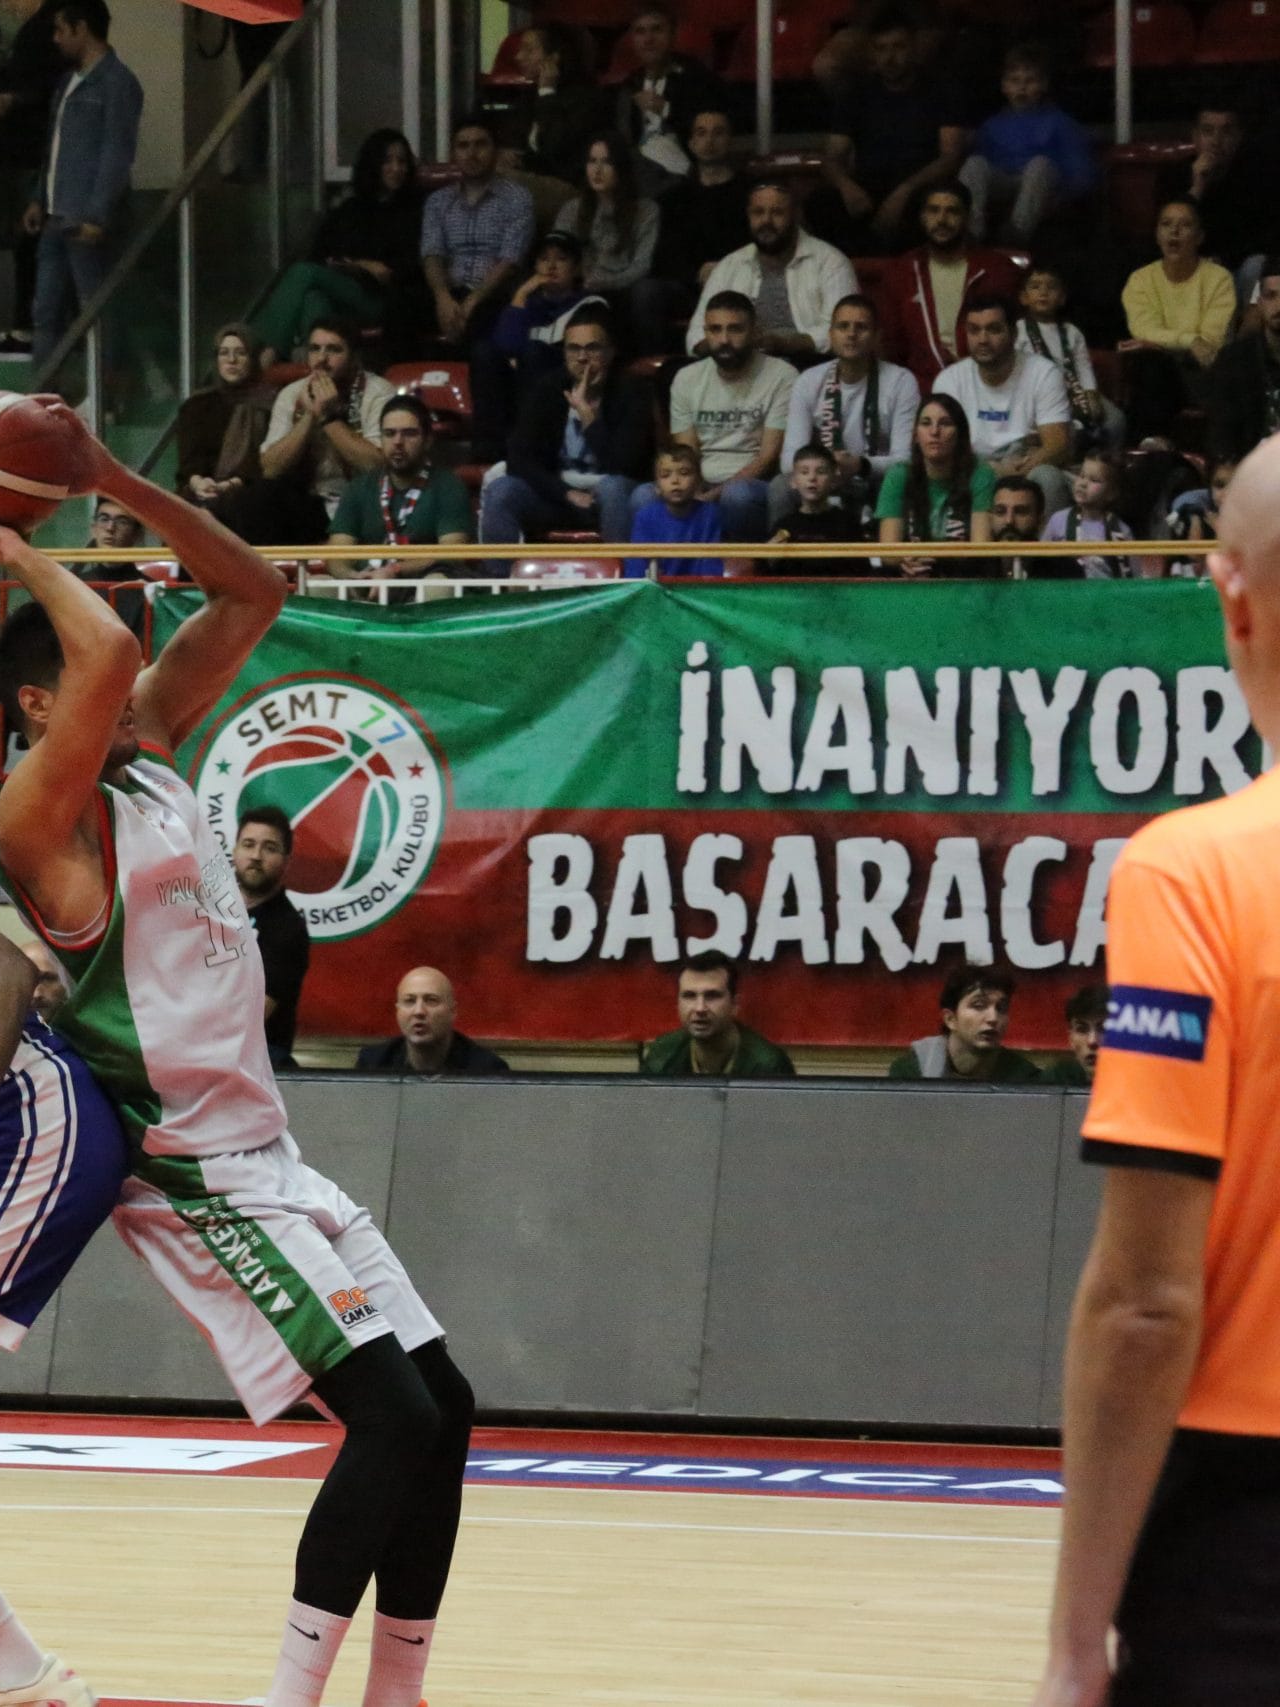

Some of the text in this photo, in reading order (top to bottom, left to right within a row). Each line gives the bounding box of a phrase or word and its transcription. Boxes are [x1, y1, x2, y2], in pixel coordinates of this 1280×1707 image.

[696, 403, 764, 423] madrd
[237, 691, 407, 747] SEMT 77
[677, 641, 1273, 796] İNANIYOR
[299, 880, 397, 926] SKETBOL
[391, 794, 430, 879] KULÜBÜ
[183, 1206, 280, 1296] ATAKET
